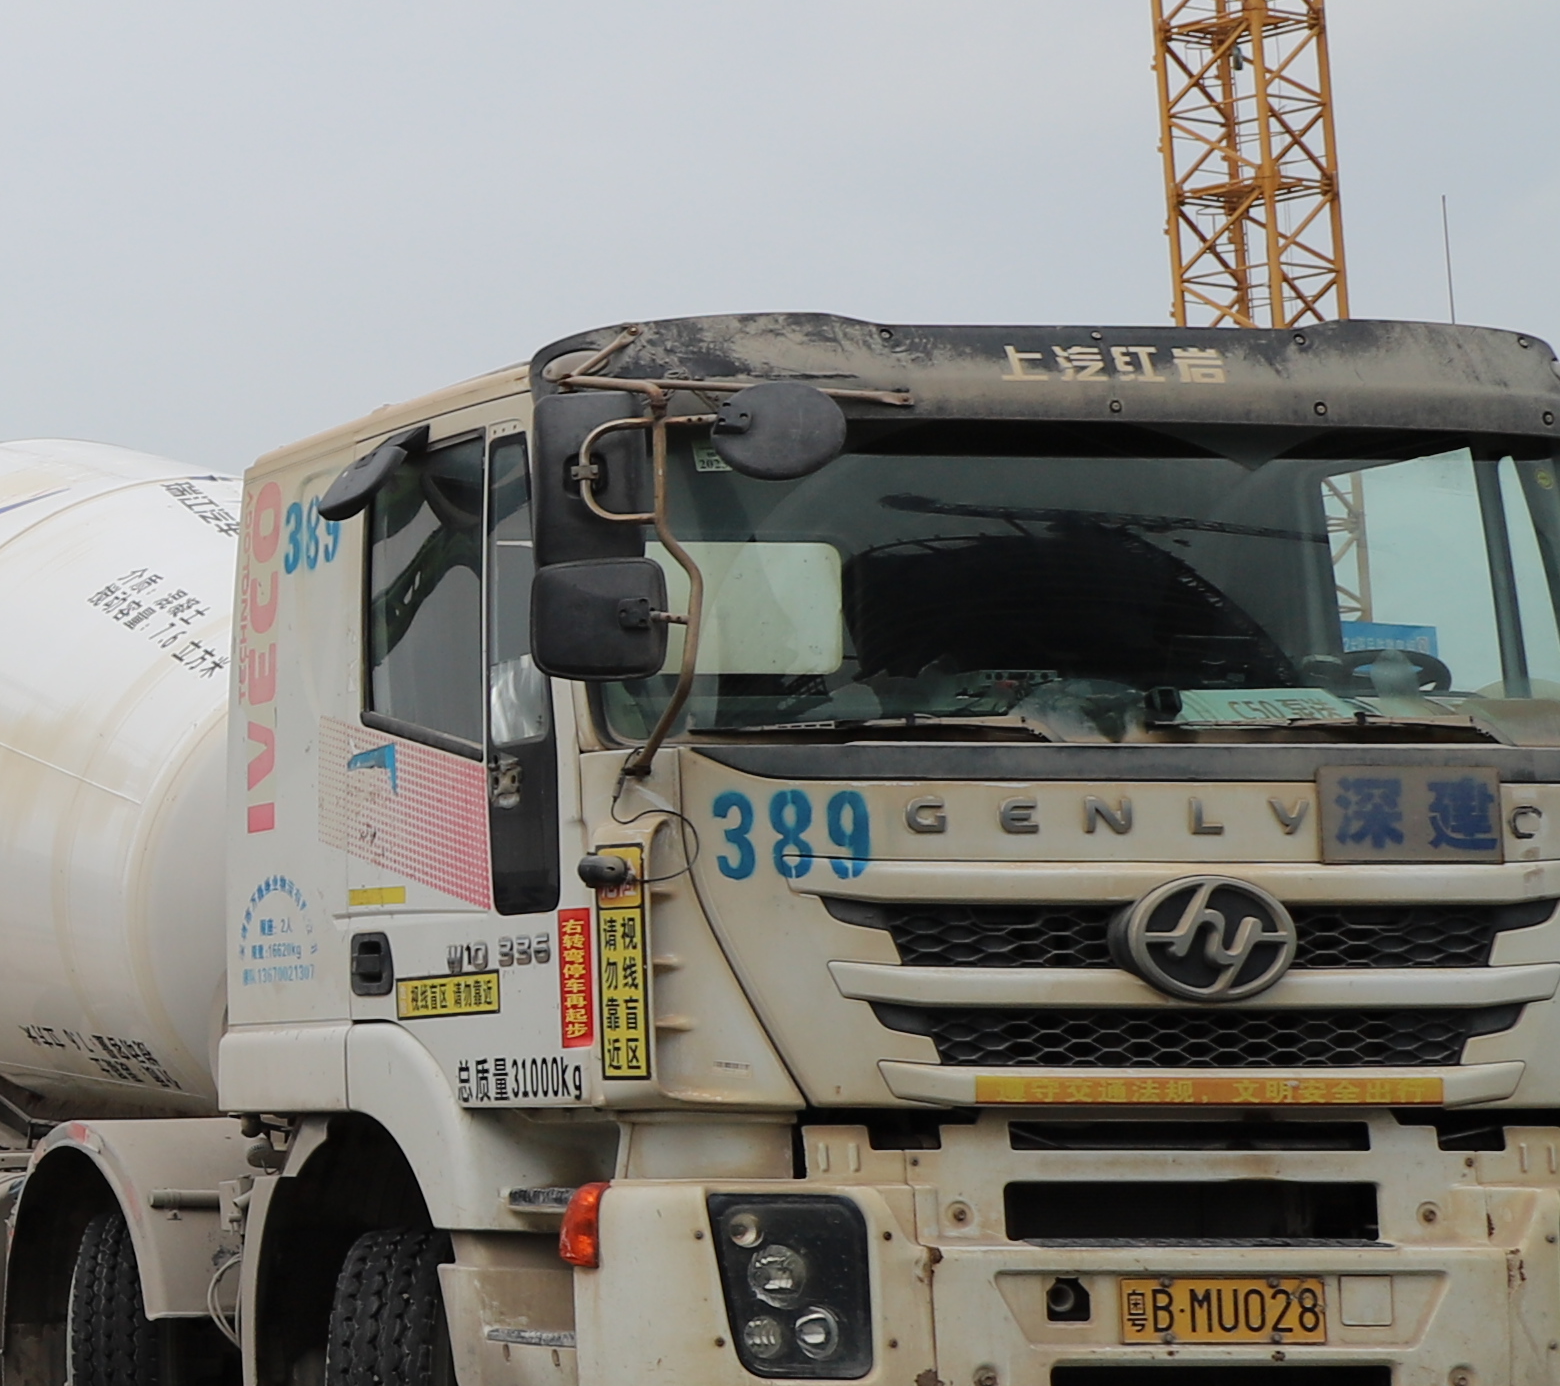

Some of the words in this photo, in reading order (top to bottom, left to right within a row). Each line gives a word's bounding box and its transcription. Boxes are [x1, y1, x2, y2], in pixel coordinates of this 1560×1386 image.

[1002, 345, 1225, 383] 上汽红岩
[247, 481, 282, 834] IVECO
[711, 789, 871, 881] 389
[1336, 777, 1497, 851] 深建
[498, 932, 551, 967] 336
[562, 919, 588, 1039] 右转弯停车再起步
[603, 917, 623, 1070] 请勿靠近
[621, 917, 641, 1070] 视线盲区
[457, 1056, 582, 1102] 总质量31000kg
